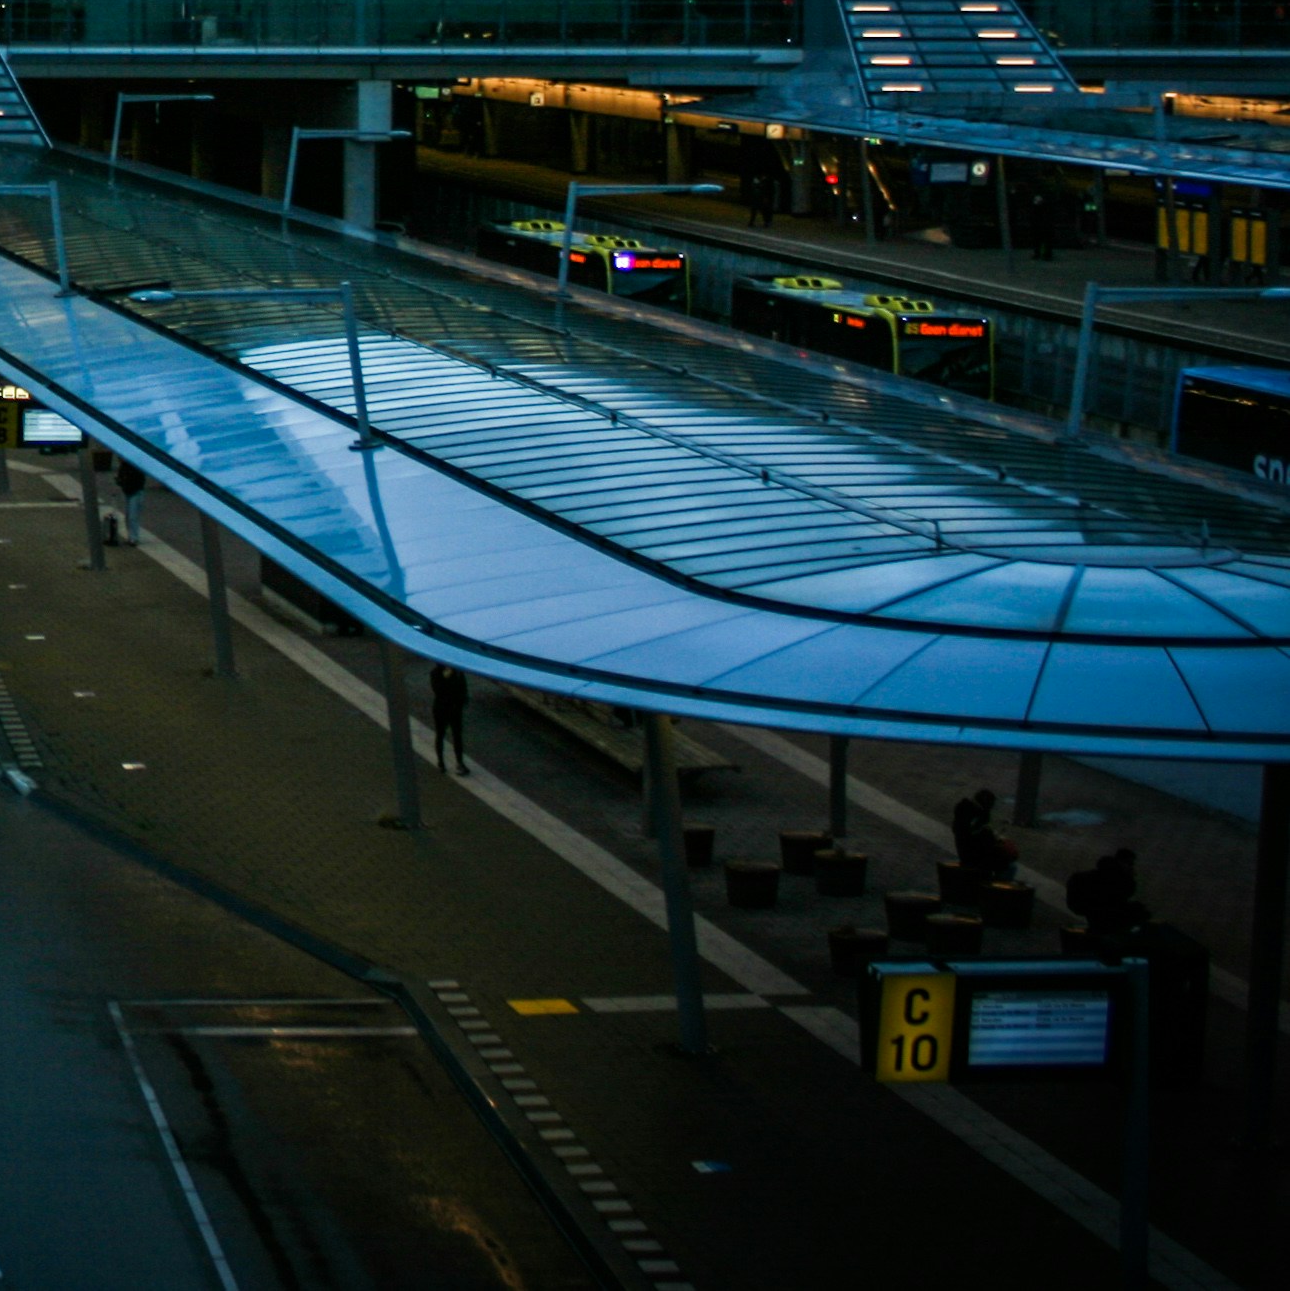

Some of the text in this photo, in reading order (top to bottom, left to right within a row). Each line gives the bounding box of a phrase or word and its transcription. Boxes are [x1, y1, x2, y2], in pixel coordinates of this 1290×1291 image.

[920, 323, 946, 336] Geen
[948, 324, 983, 337] dienst
[1253, 454, 1290, 486] sn
[904, 988, 930, 1025] C
[891, 1033, 938, 1072] 10
